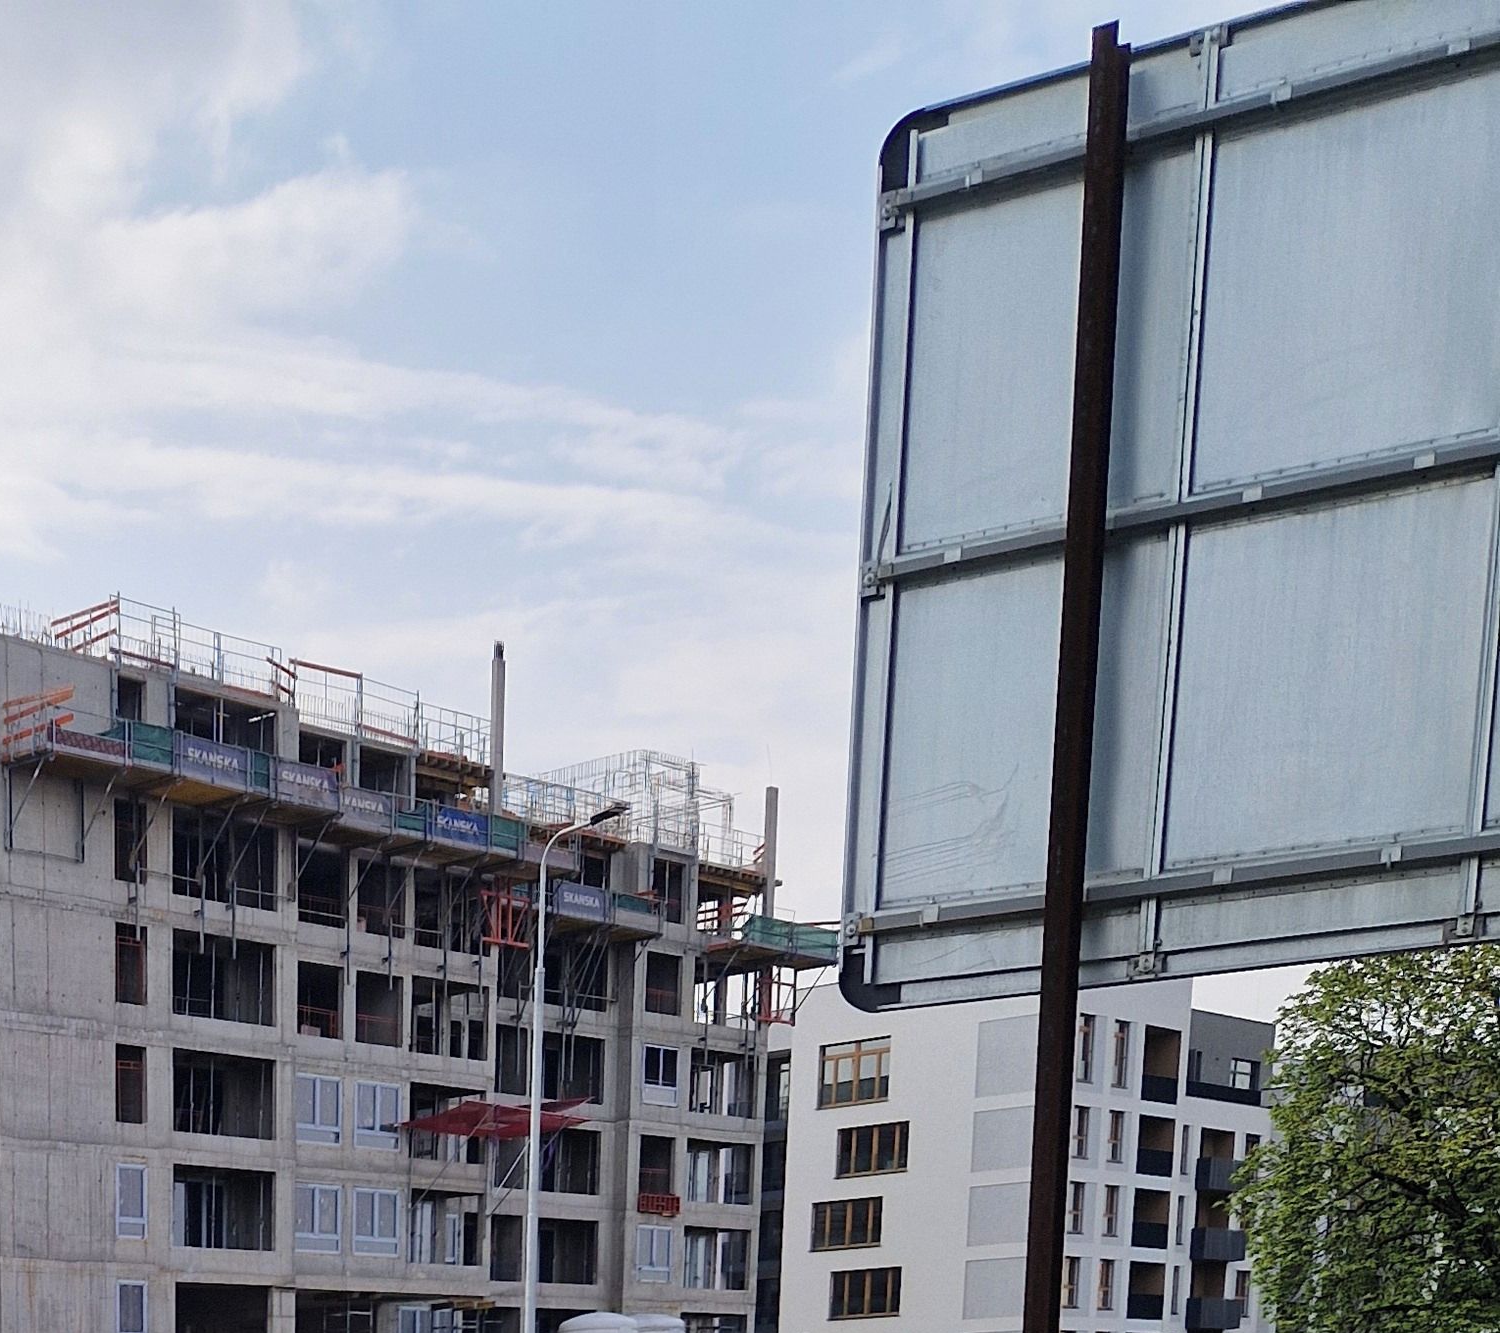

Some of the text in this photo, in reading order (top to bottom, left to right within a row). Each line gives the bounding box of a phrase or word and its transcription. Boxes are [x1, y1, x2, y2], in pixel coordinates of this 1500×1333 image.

[187, 746, 239, 769] SKANSKA
[282, 770, 329, 790] SKANSKA
[343, 795, 384, 814] KANSKA
[563, 891, 600, 907] SKANSKA
